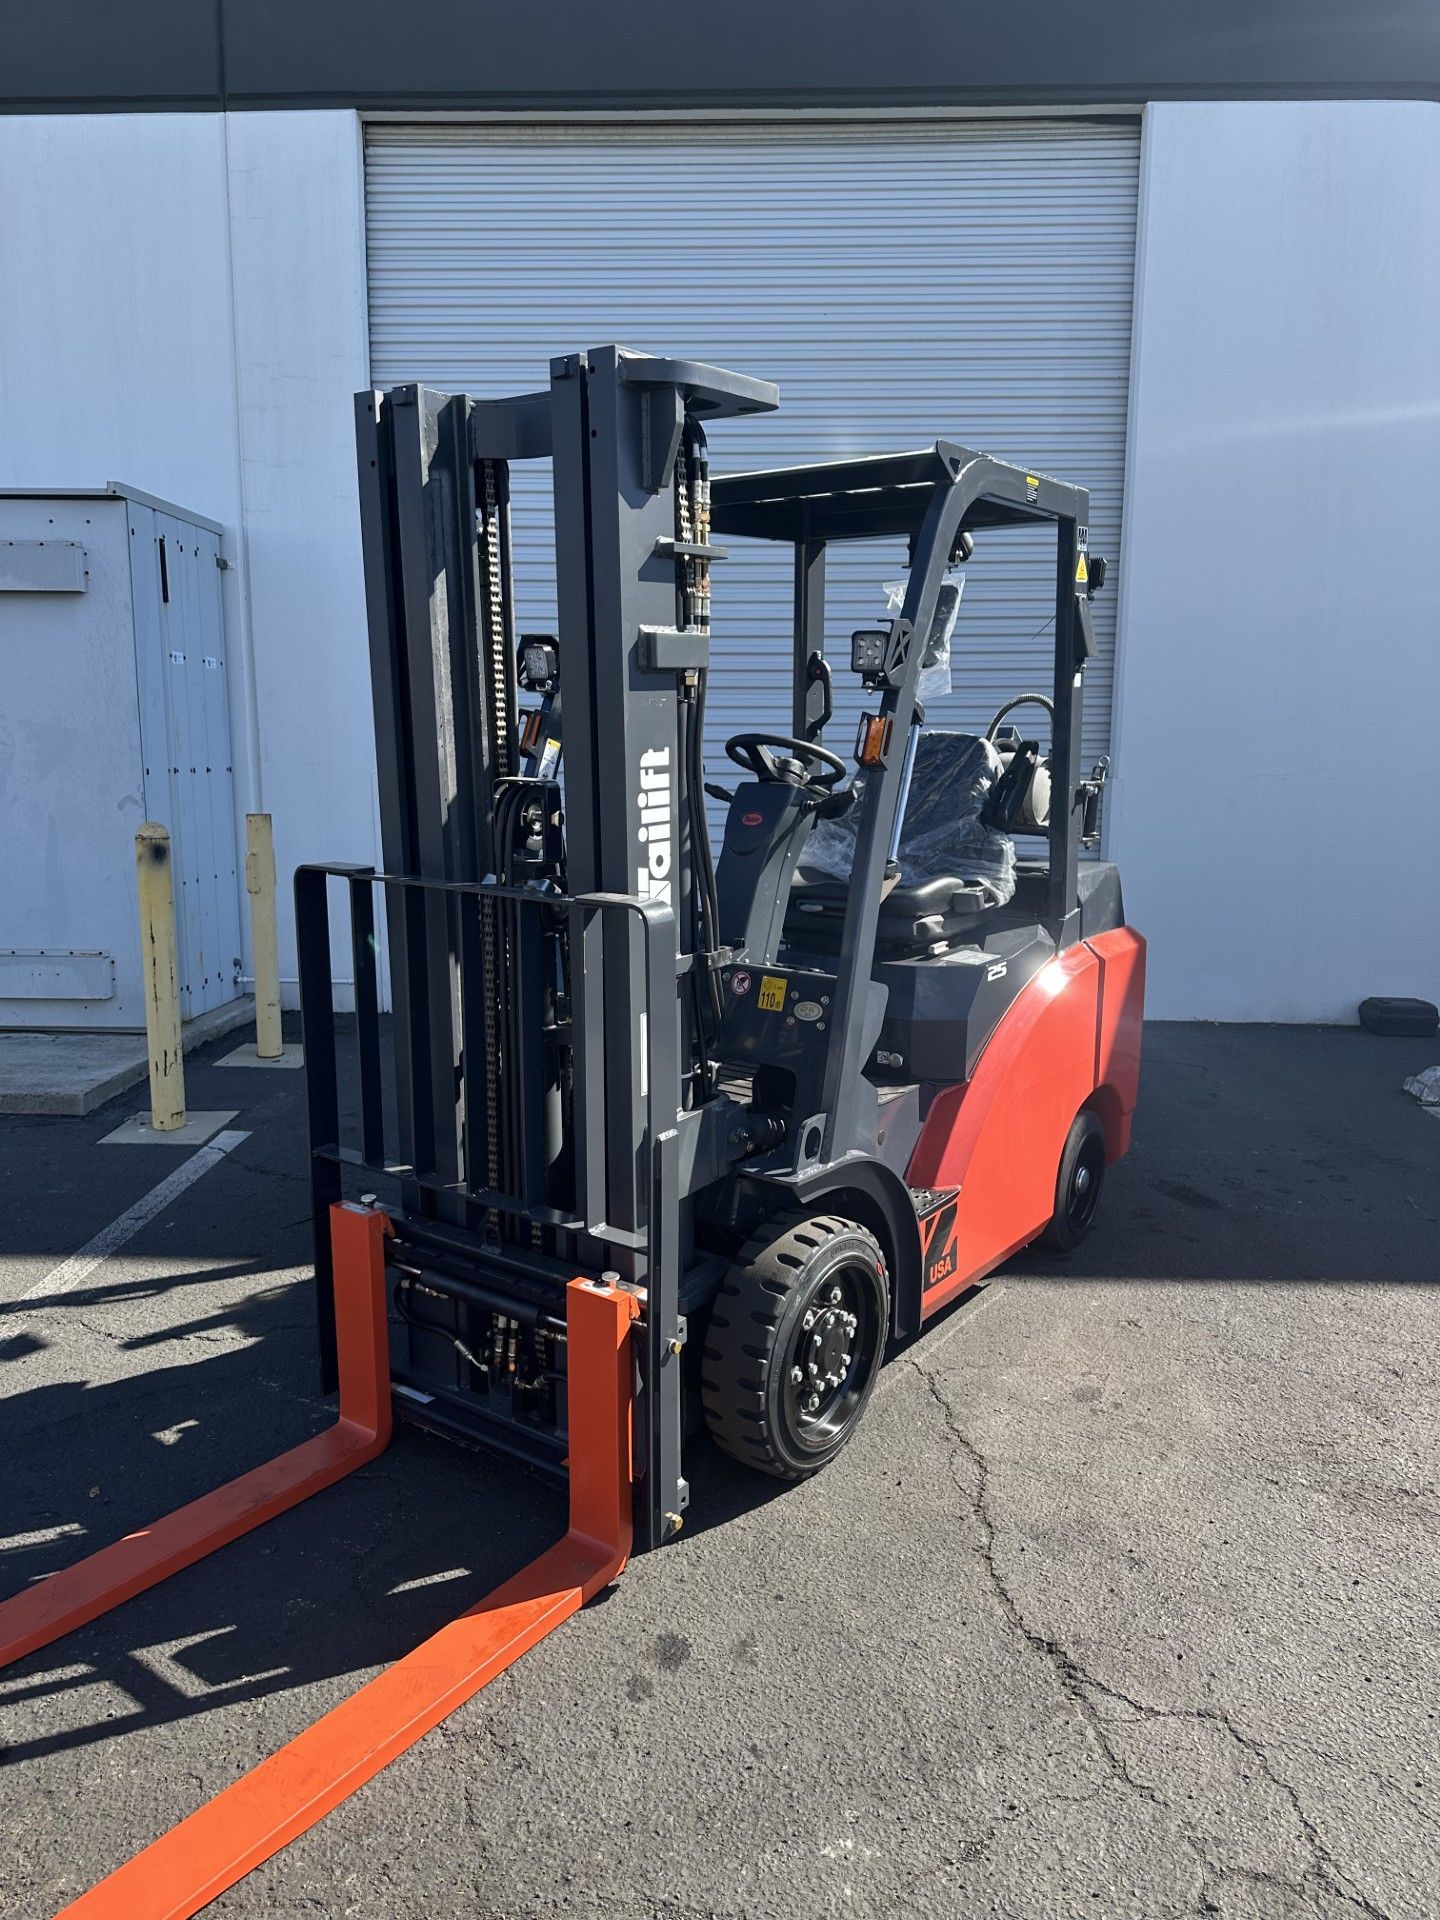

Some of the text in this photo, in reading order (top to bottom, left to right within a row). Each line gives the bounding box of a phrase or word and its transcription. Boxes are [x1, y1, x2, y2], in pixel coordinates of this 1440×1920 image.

[987, 962, 1007, 982] 25
[761, 991, 776, 1008] 110
[930, 1256, 952, 1283] USA
